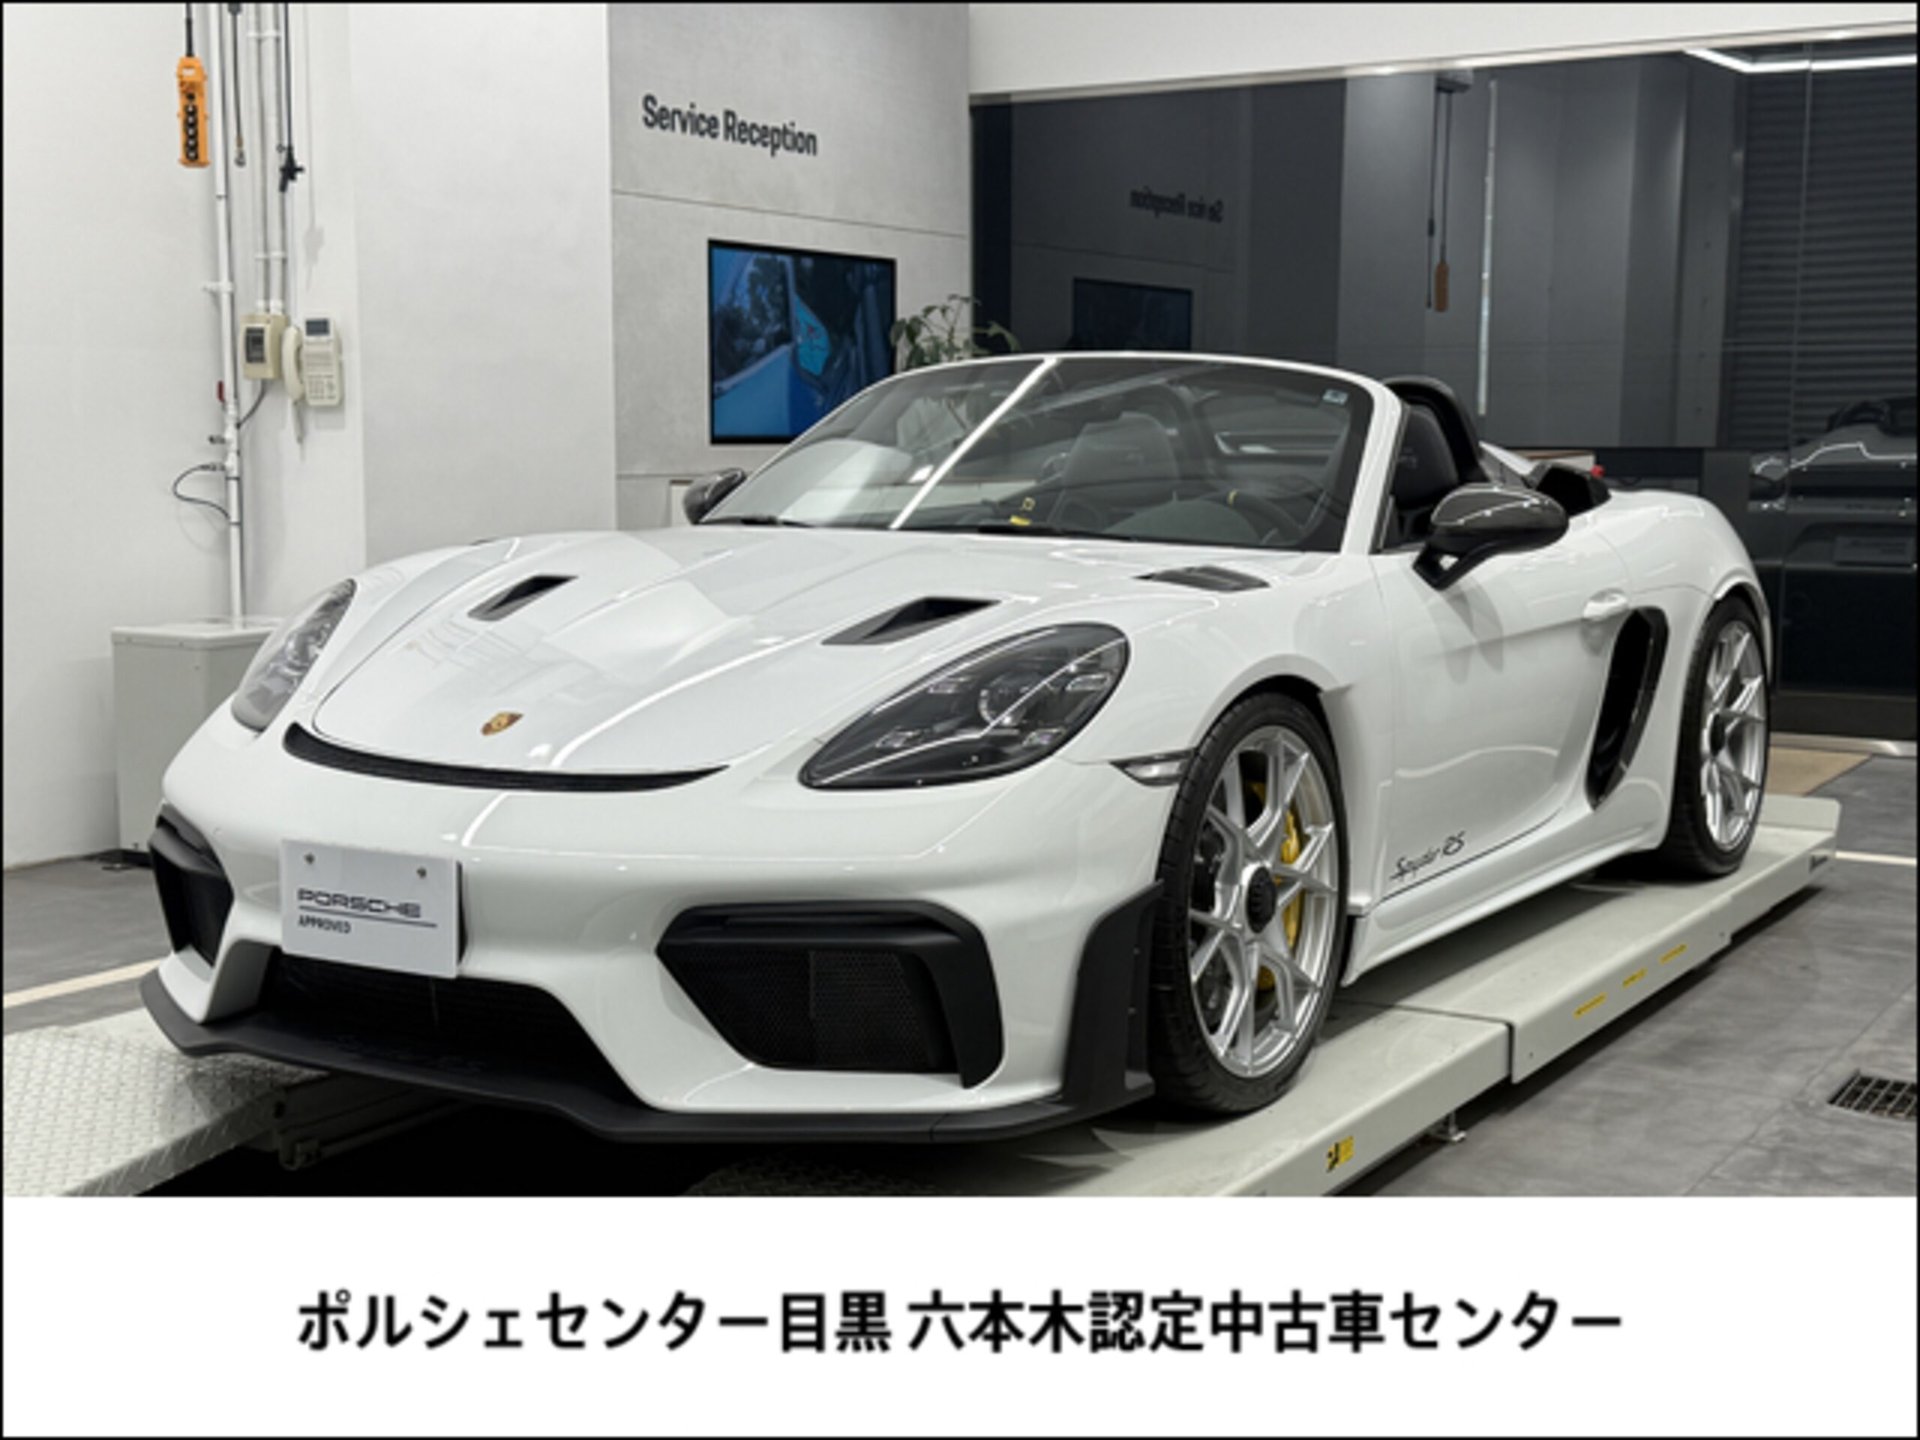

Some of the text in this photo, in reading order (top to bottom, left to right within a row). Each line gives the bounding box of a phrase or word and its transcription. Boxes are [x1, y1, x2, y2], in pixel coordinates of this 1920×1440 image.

[642, 93, 817, 157] Service Reception
[298, 888, 421, 918] PORSCHE
[298, 915, 352, 934] APPROVED
